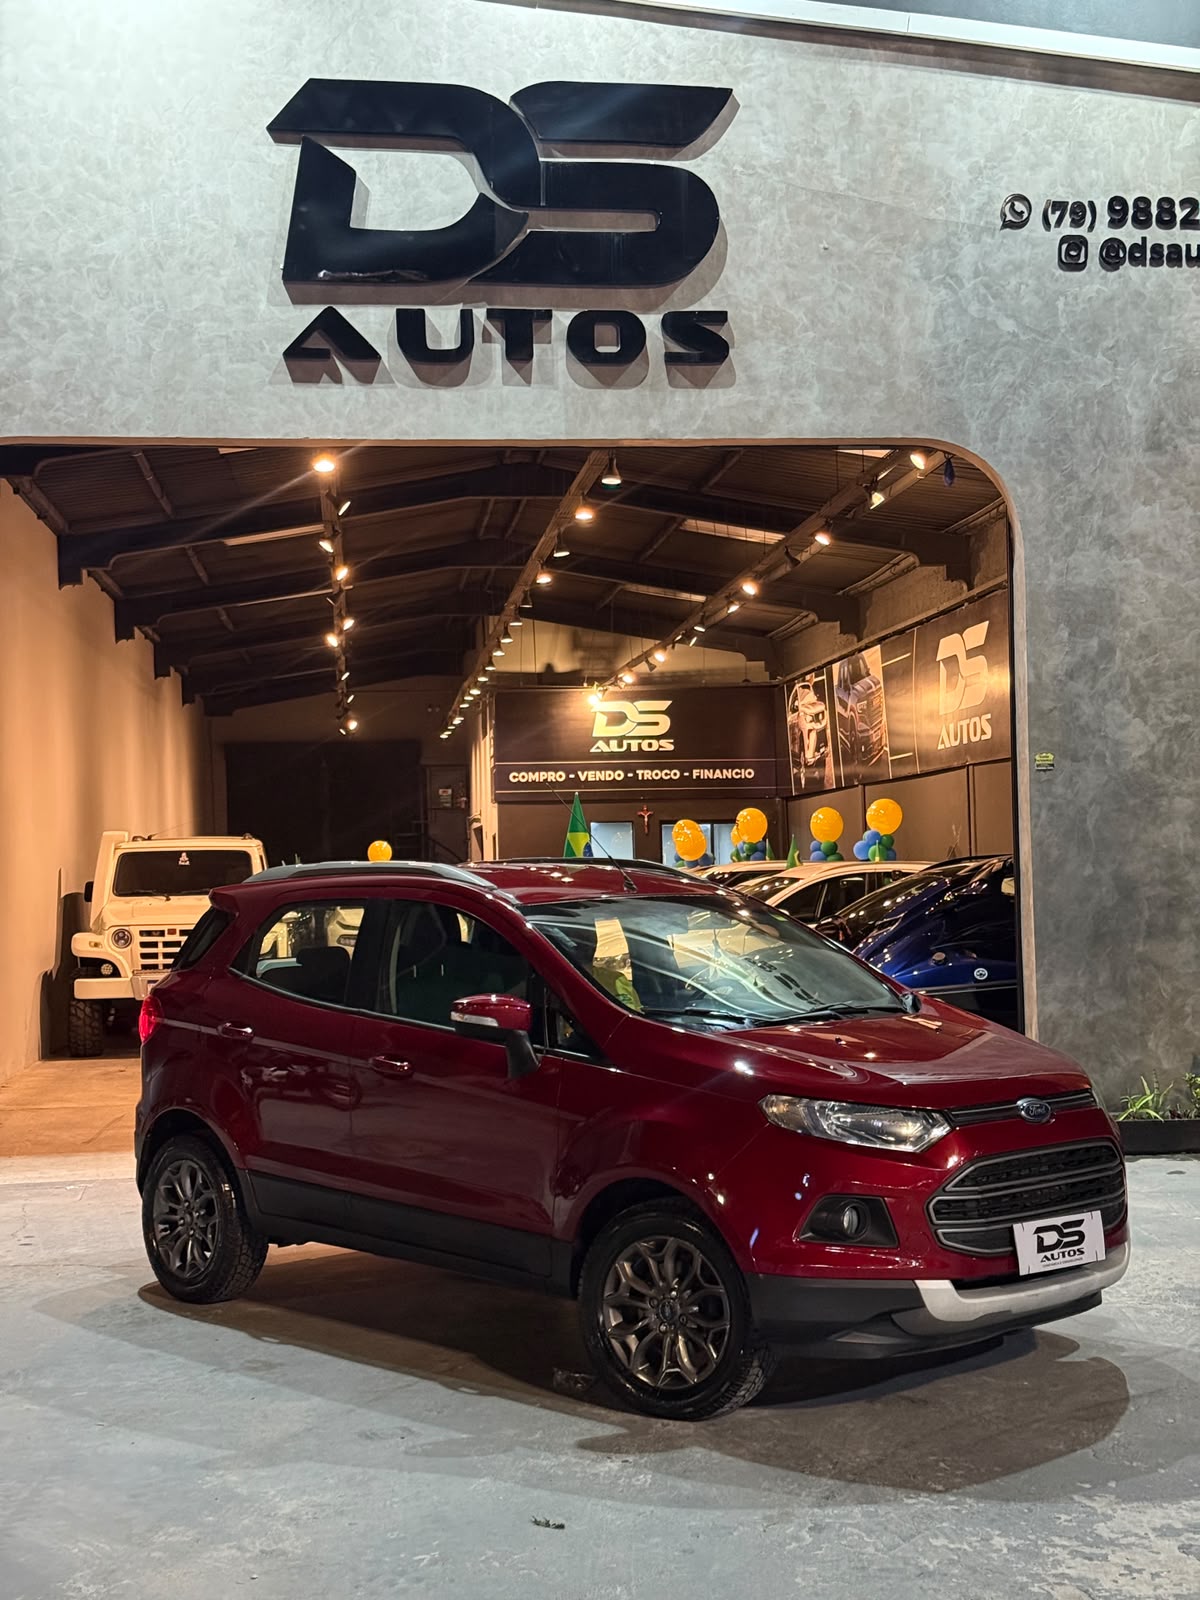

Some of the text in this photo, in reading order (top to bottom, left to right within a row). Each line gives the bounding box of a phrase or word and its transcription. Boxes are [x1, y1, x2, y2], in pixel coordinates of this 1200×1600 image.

[266, 77, 735, 290] DS
[1042, 198, 1097, 232] (79)
[1098, 236, 1200, 272] @dsau
[282, 305, 730, 370] AUTOS
[936, 620, 990, 715] DS
[591, 700, 673, 737] DS
[938, 714, 992, 750] AUTOS
[590, 739, 675, 753] AUTOS
[509, 771, 566, 783] COMPRO
[577, 769, 625, 782] VENDO
[636, 769, 681, 781] TROCO
[692, 768, 755, 780] FINANCIO
[1033, 1218, 1086, 1254] DS
[1040, 1247, 1086, 1263] AUTOS
